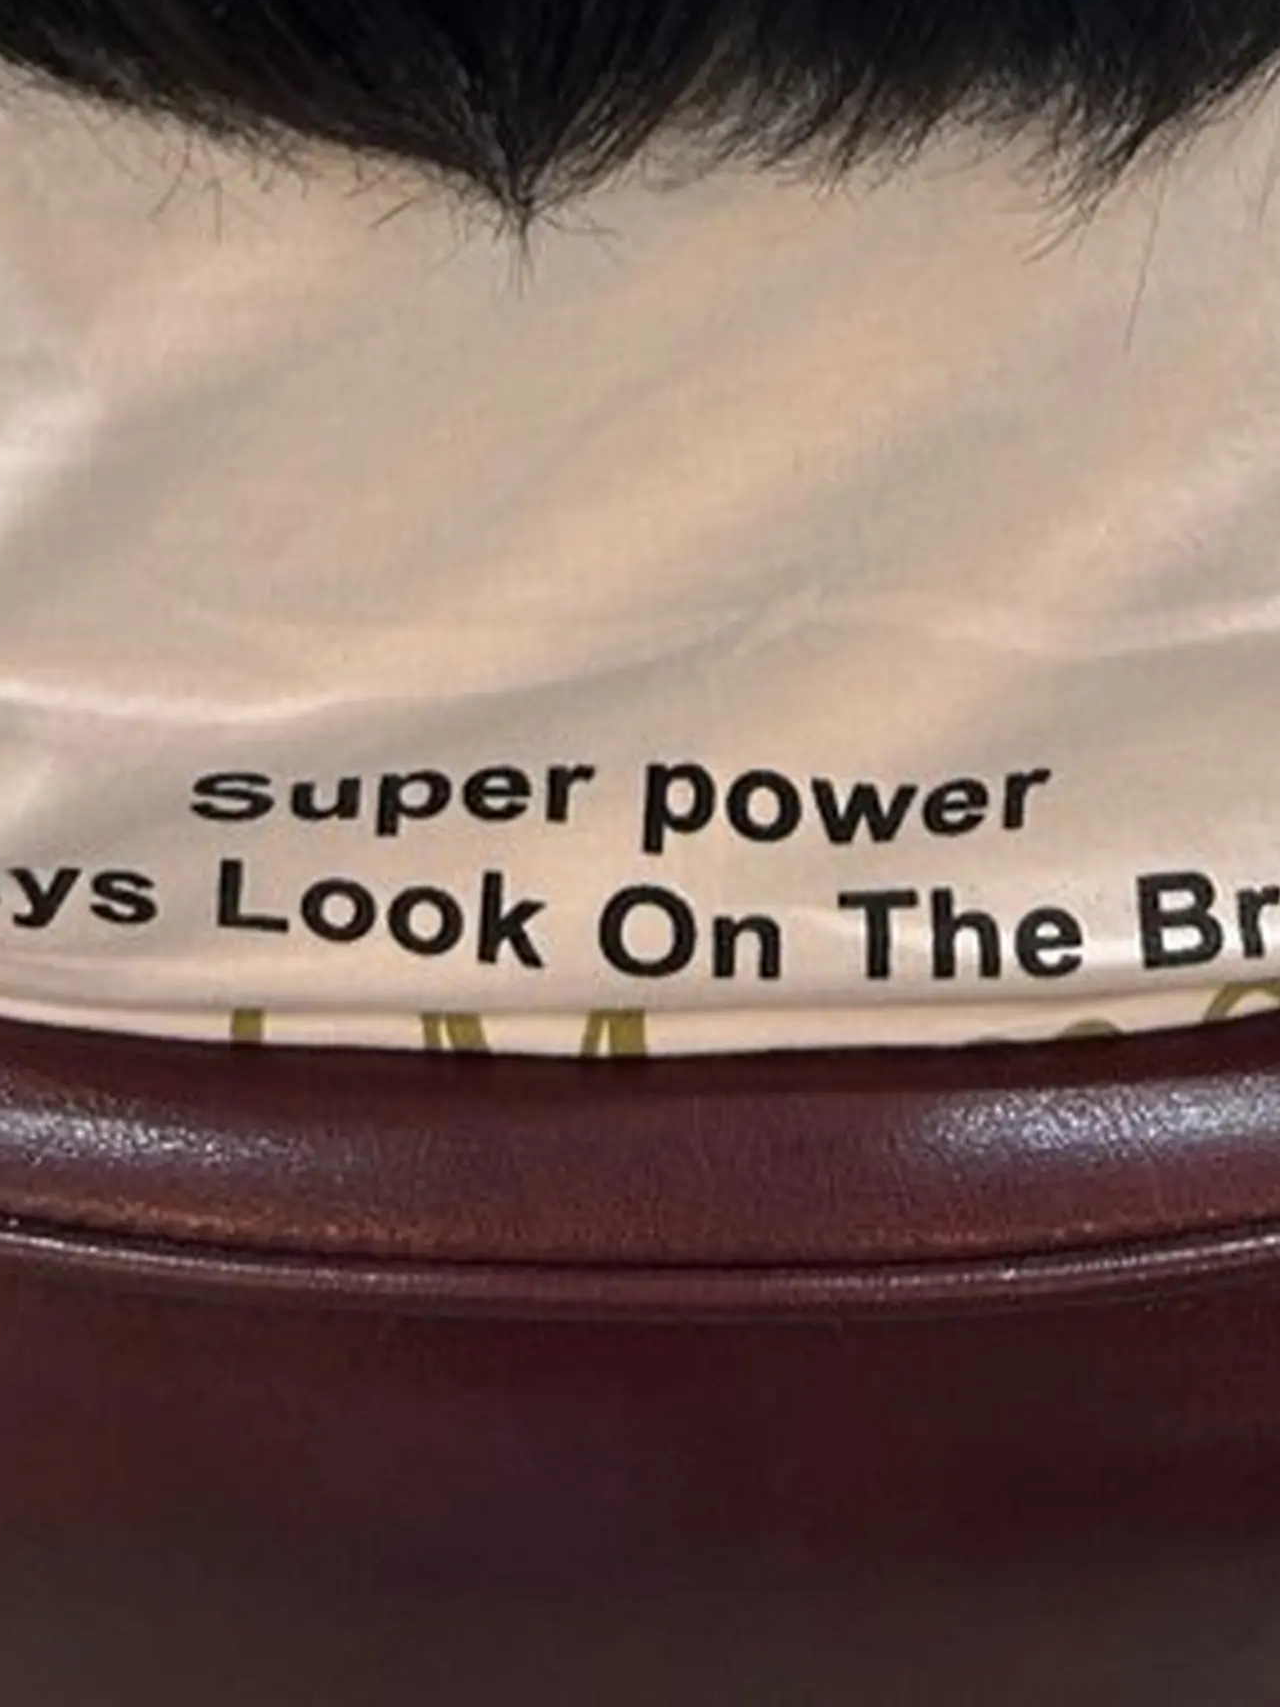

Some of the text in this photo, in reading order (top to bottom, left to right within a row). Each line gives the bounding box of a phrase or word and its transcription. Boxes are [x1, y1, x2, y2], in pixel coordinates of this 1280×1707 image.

[189, 761, 1053, 857] super power
[216, 857, 546, 971] Look
[597, 884, 782, 981] On
[836, 886, 1084, 982] The
